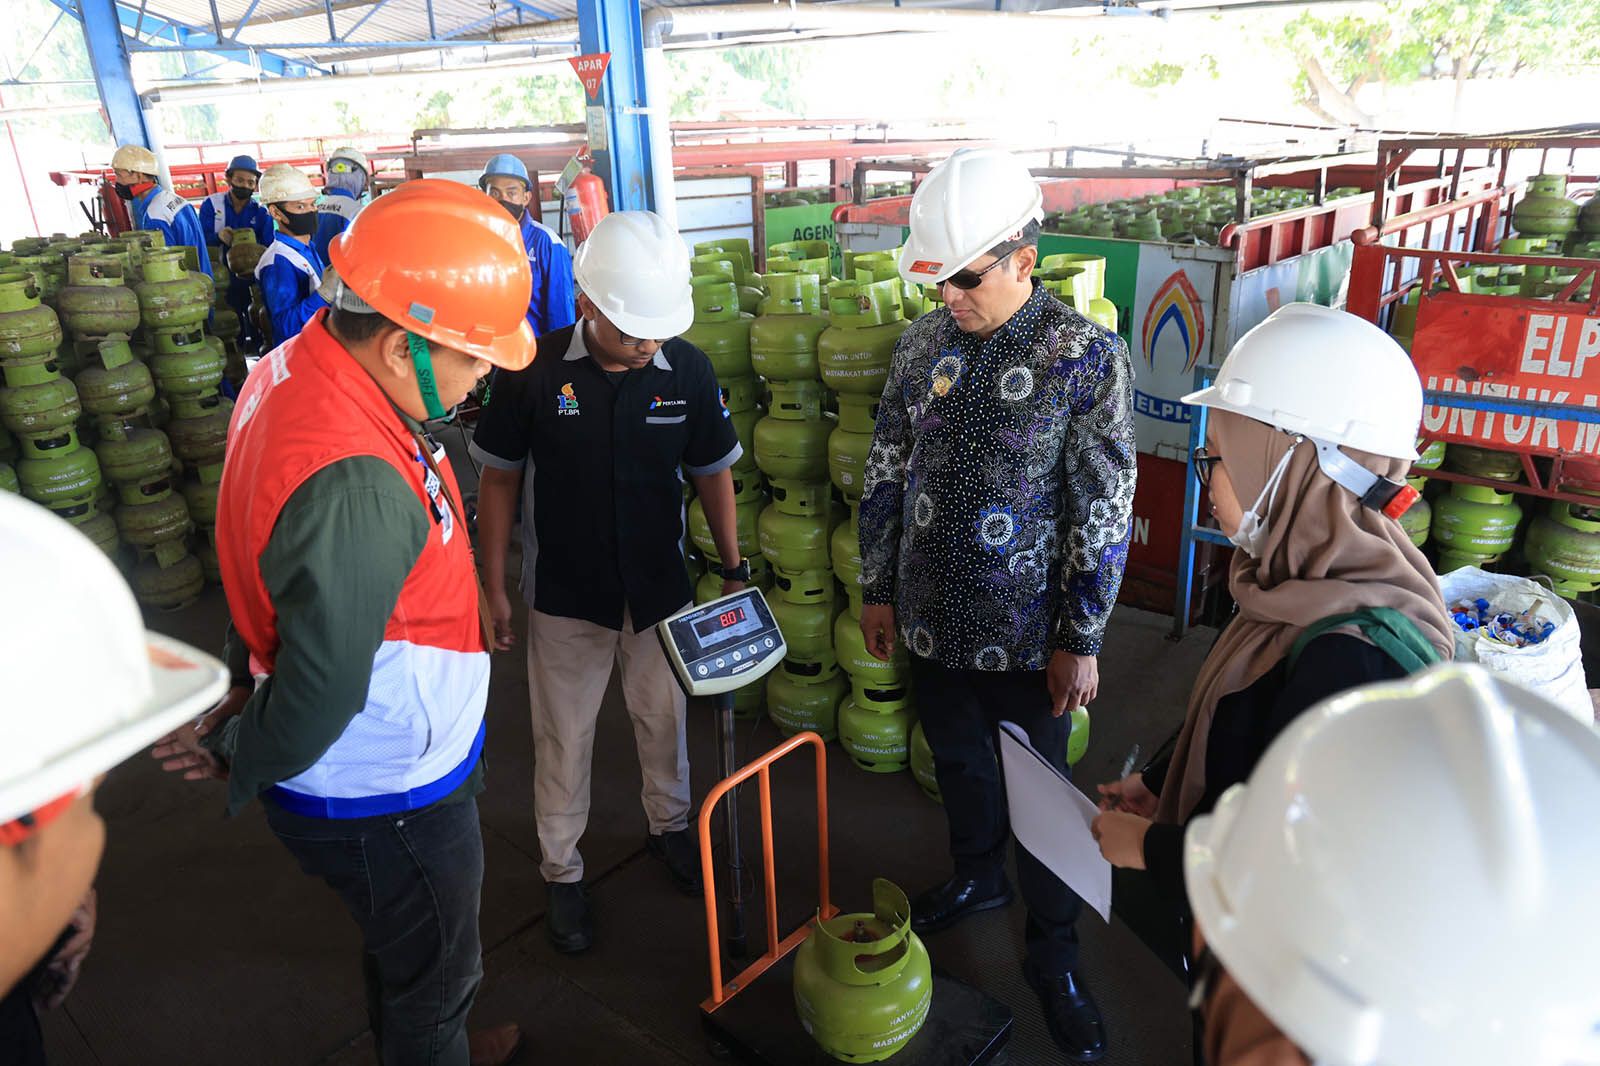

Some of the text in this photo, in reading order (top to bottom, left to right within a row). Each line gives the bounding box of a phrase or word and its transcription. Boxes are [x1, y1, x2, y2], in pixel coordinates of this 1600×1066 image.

[577, 58, 603, 72] APAR
[586, 78, 597, 89] 07
[792, 224, 833, 241] AGEN
[1520, 314, 1600, 379] ELP
[1423, 376, 1570, 449] UNTUK
